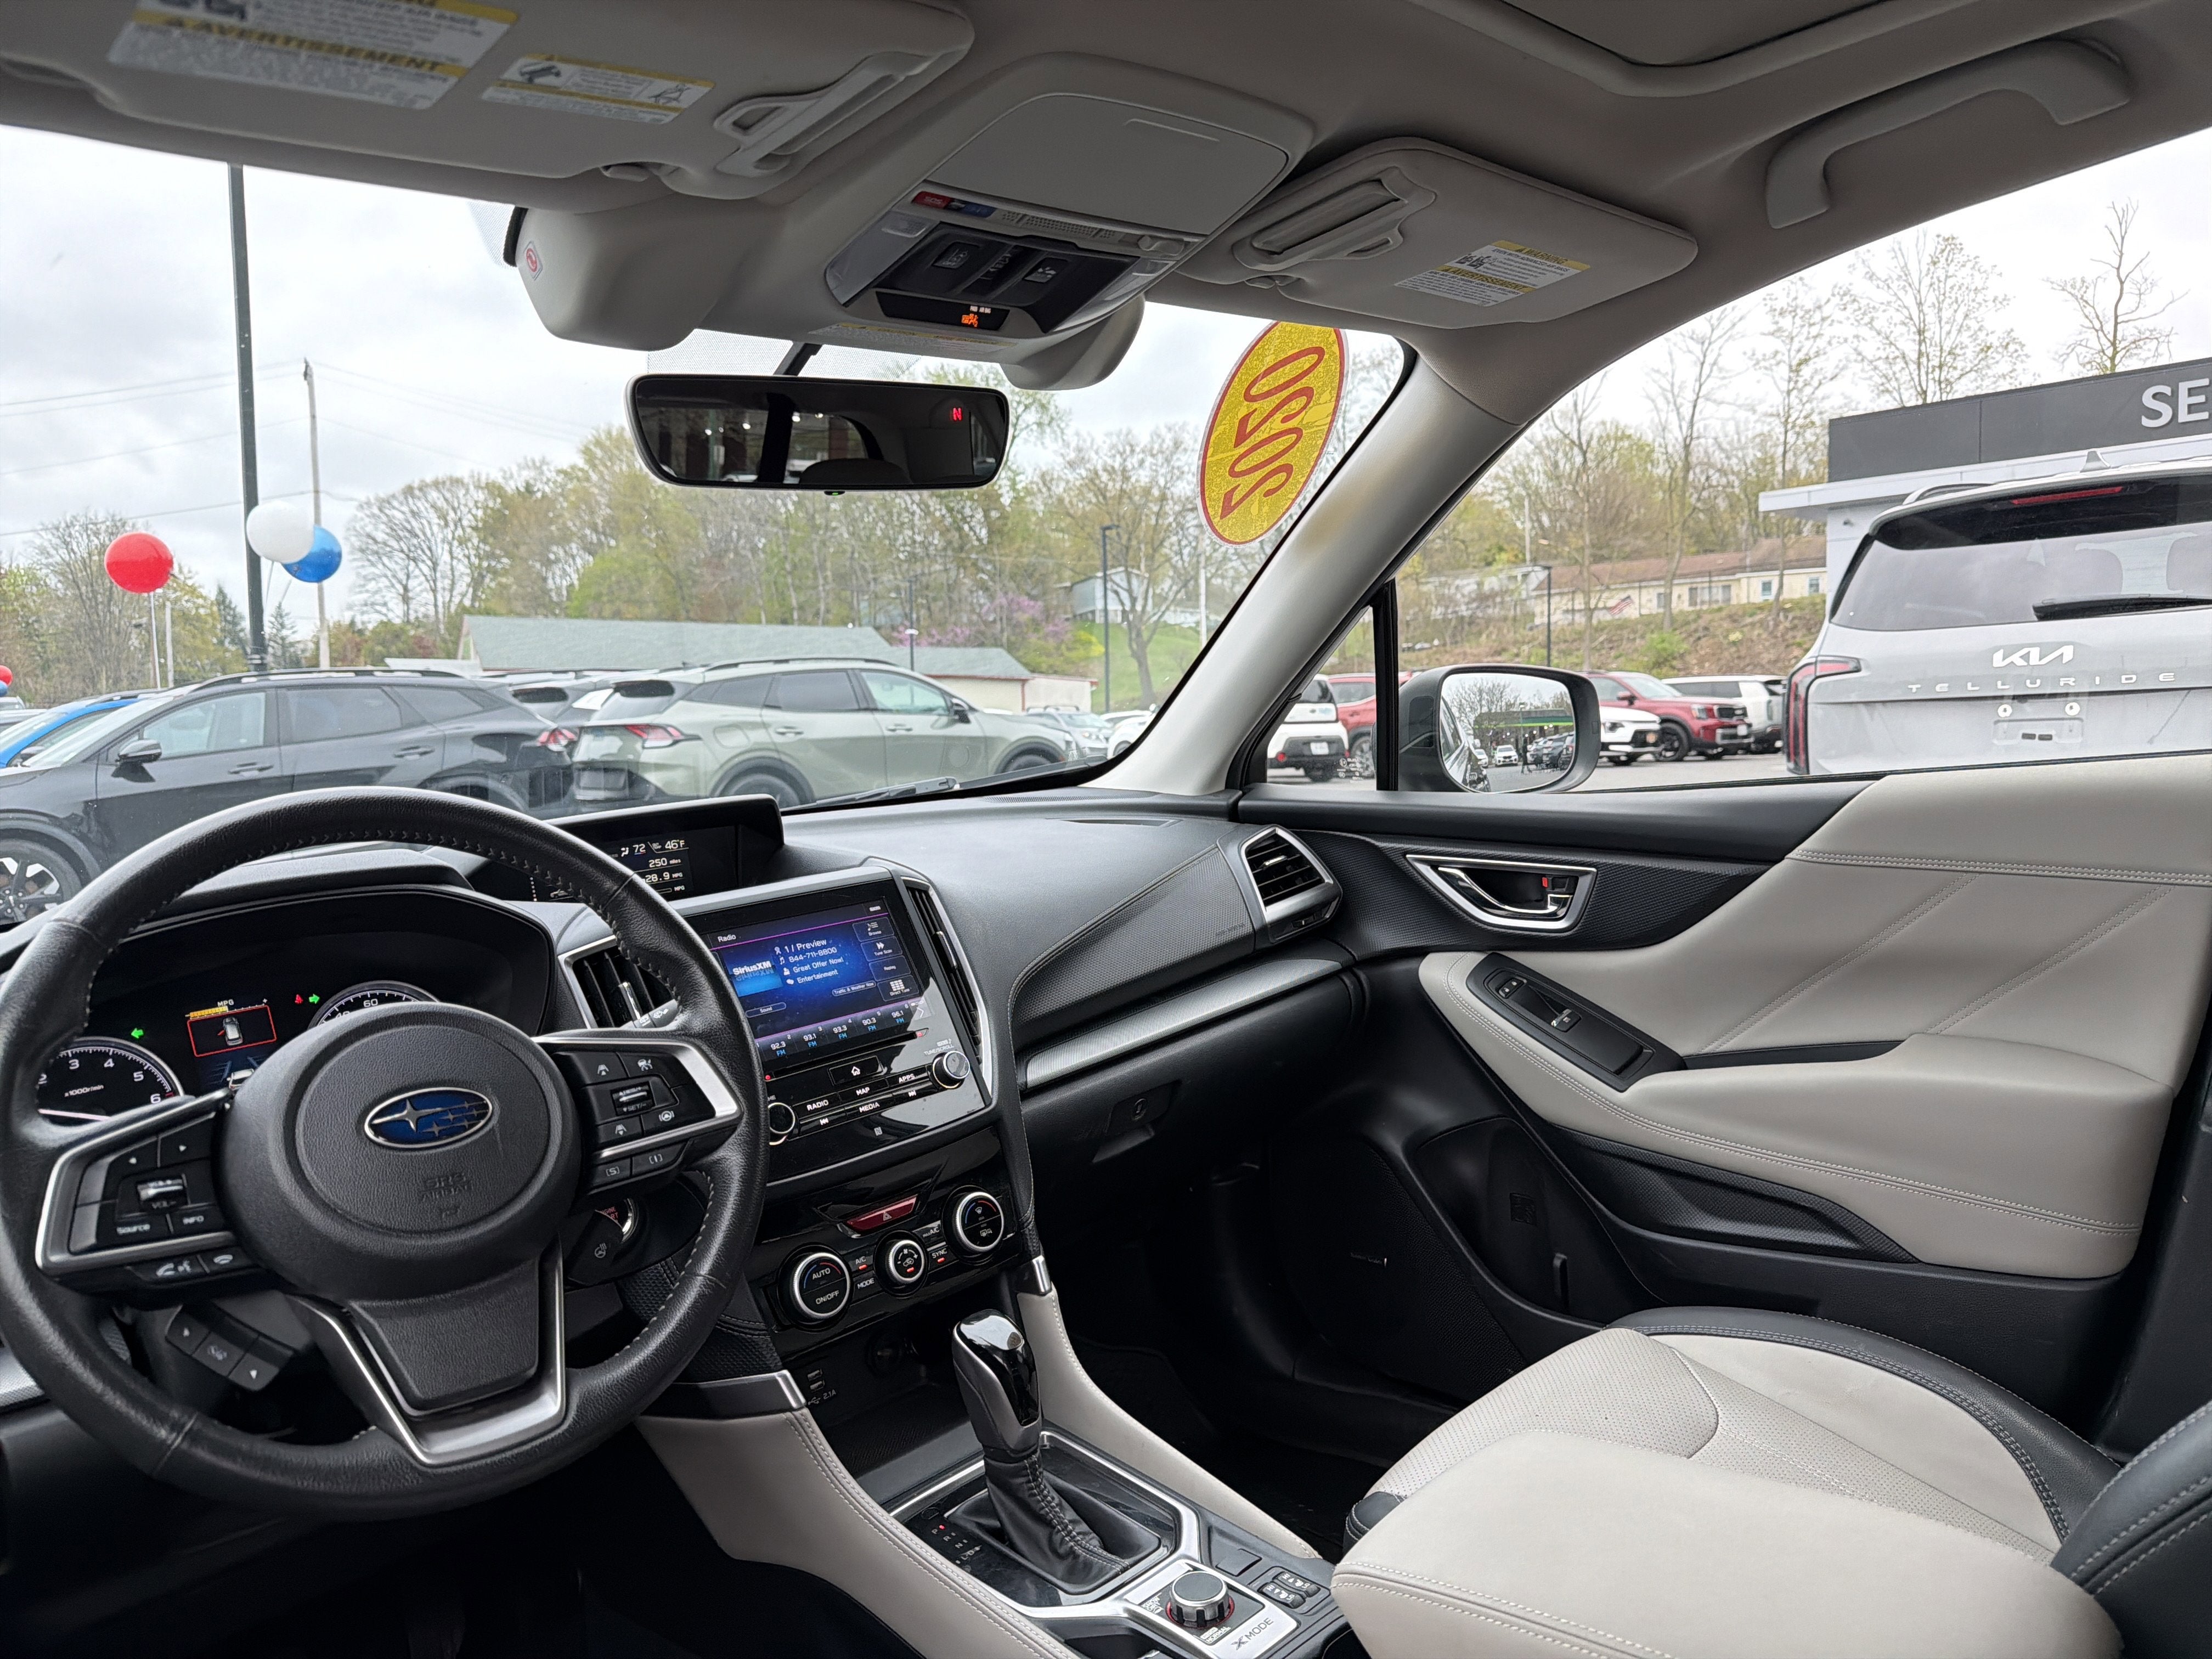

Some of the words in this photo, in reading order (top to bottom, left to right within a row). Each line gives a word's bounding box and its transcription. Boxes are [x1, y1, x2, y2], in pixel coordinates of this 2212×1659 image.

[1523, 249, 1568, 264] WARNING
[1450, 268, 1529, 291] AVERTISSEMENT
[2141, 377, 2210, 428] SE
[1993, 644, 2074, 668] KIA
[1908, 672, 2176, 693] TELLURIDE
[633, 844, 646, 853] 72
[648, 857, 668, 868] 250
[645, 872, 670, 883] 28.9
[718, 934, 736, 943] Radio
[784, 945, 790, 953] 1
[796, 939, 827, 951] Preview
[788, 946, 838, 963] 844-711-8800
[732, 960, 772, 975] SiriusXM
[793, 964, 811, 974] Great
[812, 960, 828, 969] Offer
[829, 956, 844, 965] Now!
[797, 969, 839, 984] Entertainment
[218, 998, 234, 1007] MPG
[363, 998, 378, 1008] 60
[891, 1010, 904, 1018] 96.1
[862, 1017, 877, 1026] 90.3
[833, 1025, 848, 1034] 93.3
[803, 1033, 817, 1042] 93.1
[770, 1041, 786, 1050] 92.3
[924, 1044, 955, 1056] TUNE/SCROLL
[69, 1059, 80, 1070] 3
[103, 1058, 115, 1069] 4
[133, 1071, 144, 1082] 5
[899, 1074, 915, 1084] APPS
[856, 1086, 870, 1096] MAP
[150, 1093, 161, 1104] 6
[806, 1099, 829, 1111] RADIO
[859, 1102, 880, 1114] MEDIA
[930, 1226, 940, 1235] A/C
[932, 1248, 947, 1259] SYNC
[855, 1256, 867, 1265] A/C
[812, 1268, 831, 1279] AUTO
[857, 1278, 875, 1289] MODE
[816, 1290, 839, 1305] ON/OFF
[823, 1389, 837, 1400] 2.1A
[1244, 1617, 1274, 1640] MODE
[1205, 1626, 1231, 1643] NORMAL
